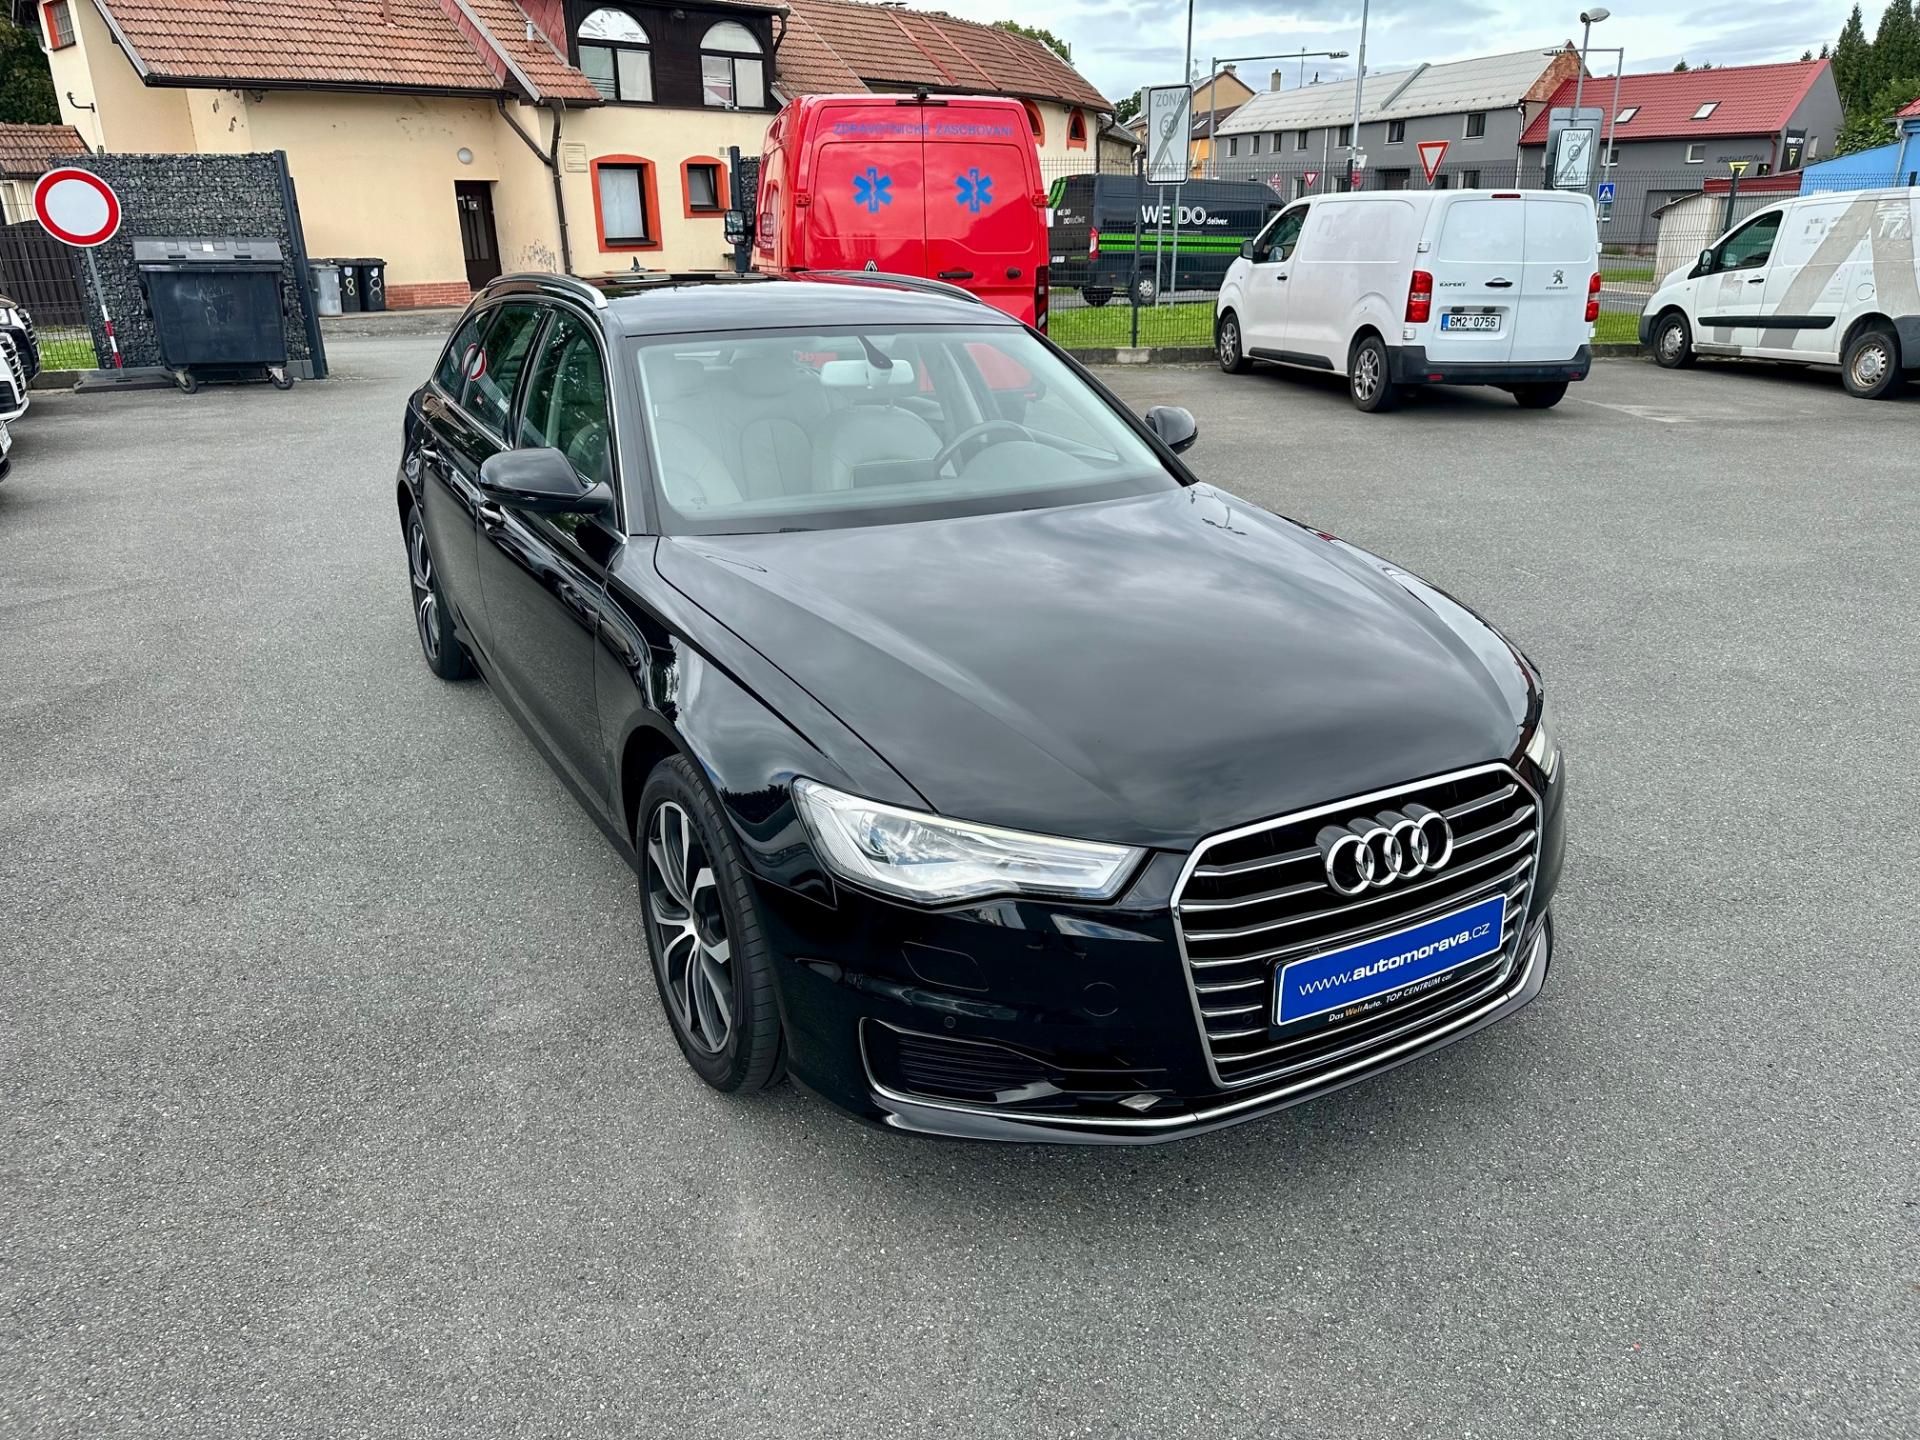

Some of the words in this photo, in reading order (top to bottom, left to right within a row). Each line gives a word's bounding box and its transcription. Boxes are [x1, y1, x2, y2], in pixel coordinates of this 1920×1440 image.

[1450, 316, 1467, 327] 6M2
[1474, 317, 1496, 328] 0756
[1299, 923, 1490, 996] www.automorava.cz
[1328, 1013, 1344, 1022] Das
[1385, 991, 1403, 1004] TOP
[1403, 976, 1441, 997] CENTRUM
